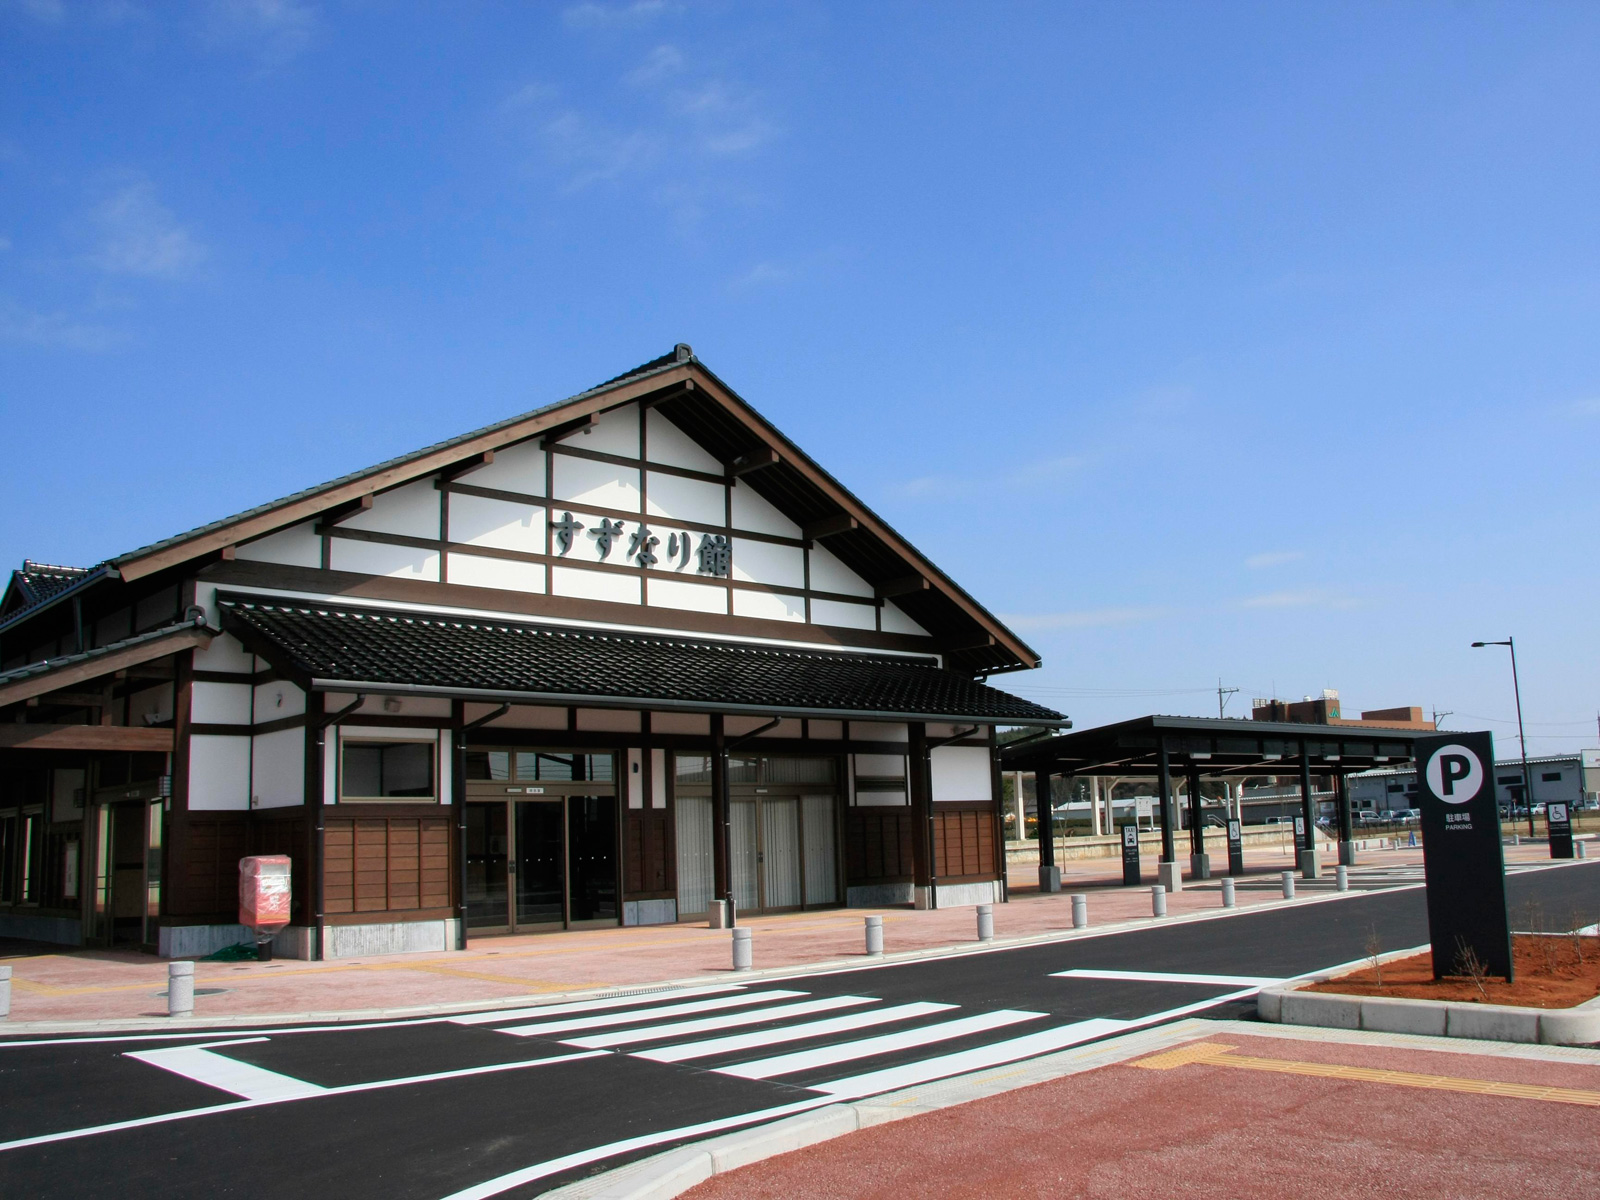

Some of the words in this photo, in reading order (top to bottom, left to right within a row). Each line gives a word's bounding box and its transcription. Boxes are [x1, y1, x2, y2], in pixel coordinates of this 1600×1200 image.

[550, 511, 733, 576] すずなり館
[1440, 754, 1471, 796] P
[1445, 812, 1471, 823] 駐車場
[1445, 823, 1473, 831] PARKING
